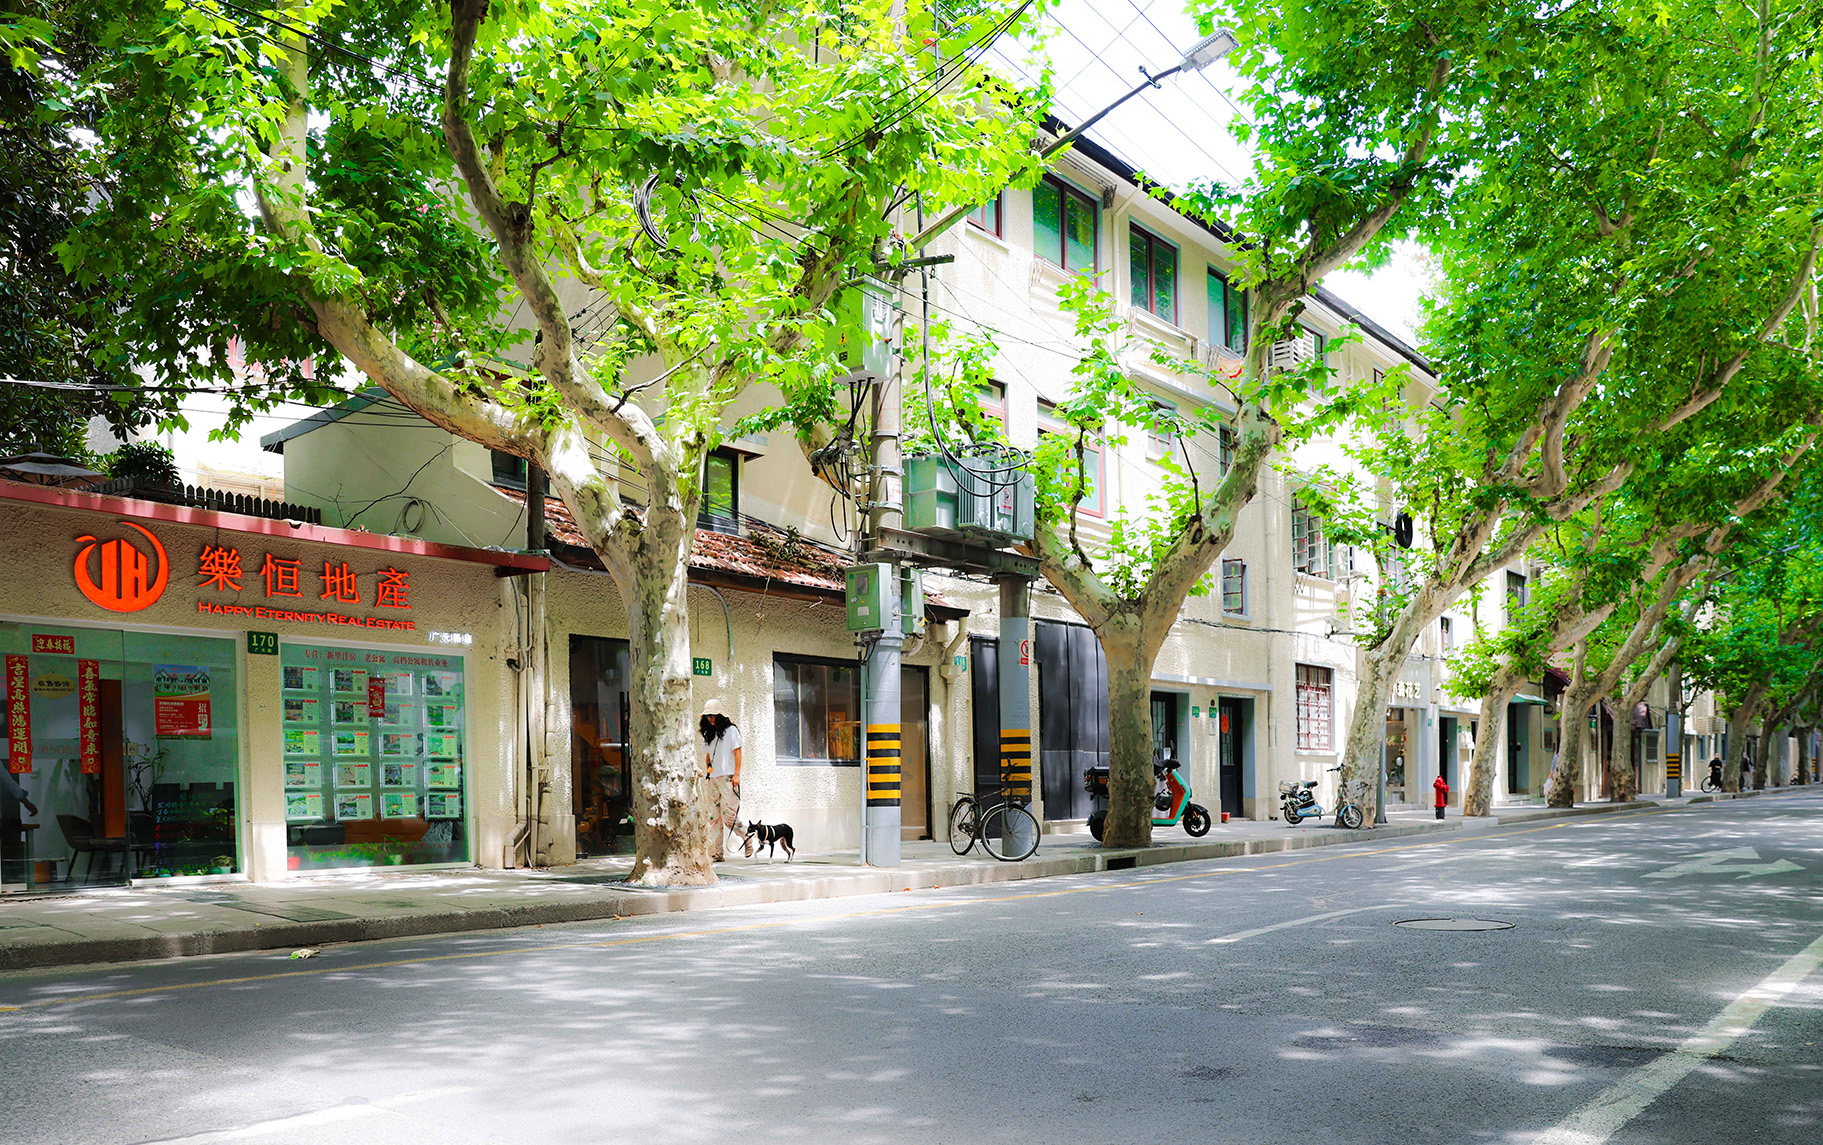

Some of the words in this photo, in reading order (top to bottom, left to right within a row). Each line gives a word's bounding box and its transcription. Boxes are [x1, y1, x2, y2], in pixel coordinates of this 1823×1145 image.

[197, 545, 412, 610] 樂恒地產
[198, 601, 254, 617] HAPPY
[255, 606, 326, 624] ETERNITY
[366, 617, 416, 631] ESTATE
[252, 634, 274, 647] 170
[695, 660, 710, 670] 168
